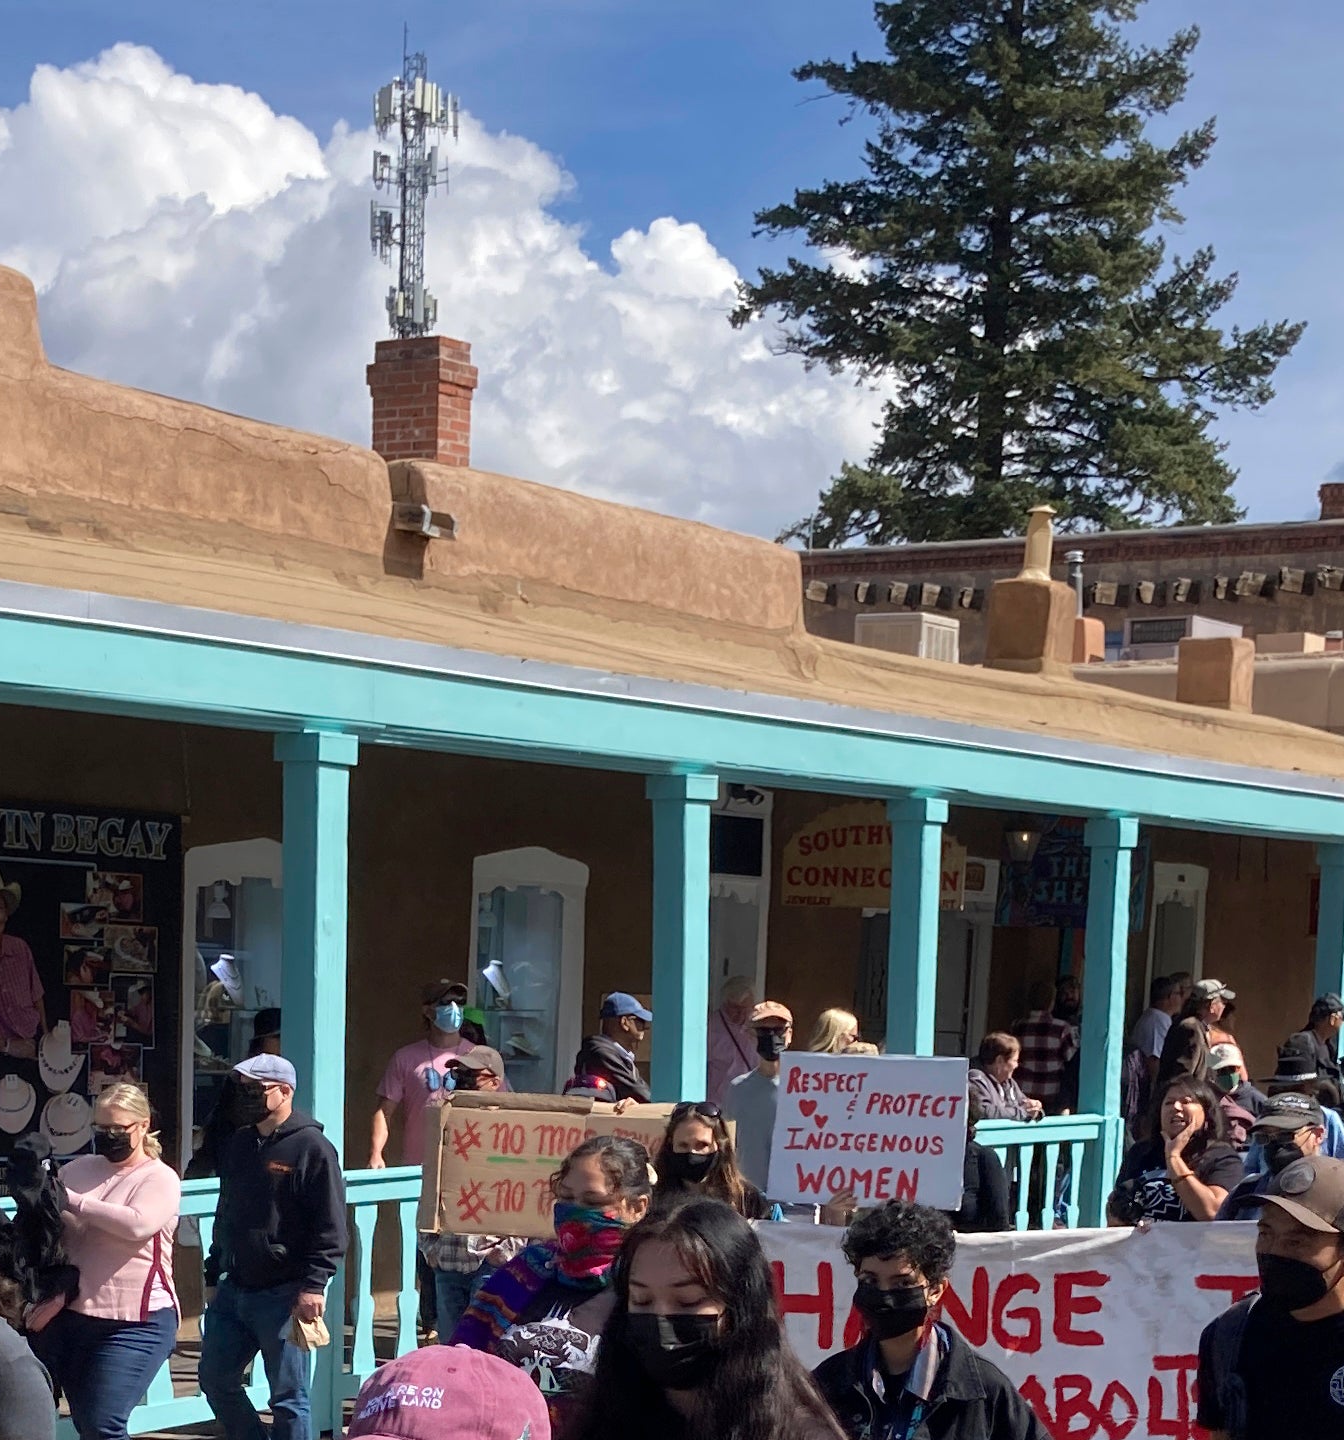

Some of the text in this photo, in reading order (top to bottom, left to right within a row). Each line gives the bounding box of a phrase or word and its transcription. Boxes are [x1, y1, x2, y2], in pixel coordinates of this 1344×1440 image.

[51, 813, 173, 861] BEGAY
[787, 866, 959, 892] CONNECN
[786, 1066, 869, 1095] RESPECT
[865, 1092, 963, 1119] PROTECT
[783, 1127, 945, 1156] INDIGENOUS
[795, 1162, 920, 1203] WOMEN
[400, 1395, 443, 1409] LAND
[421, 1386, 445, 1399] ON
